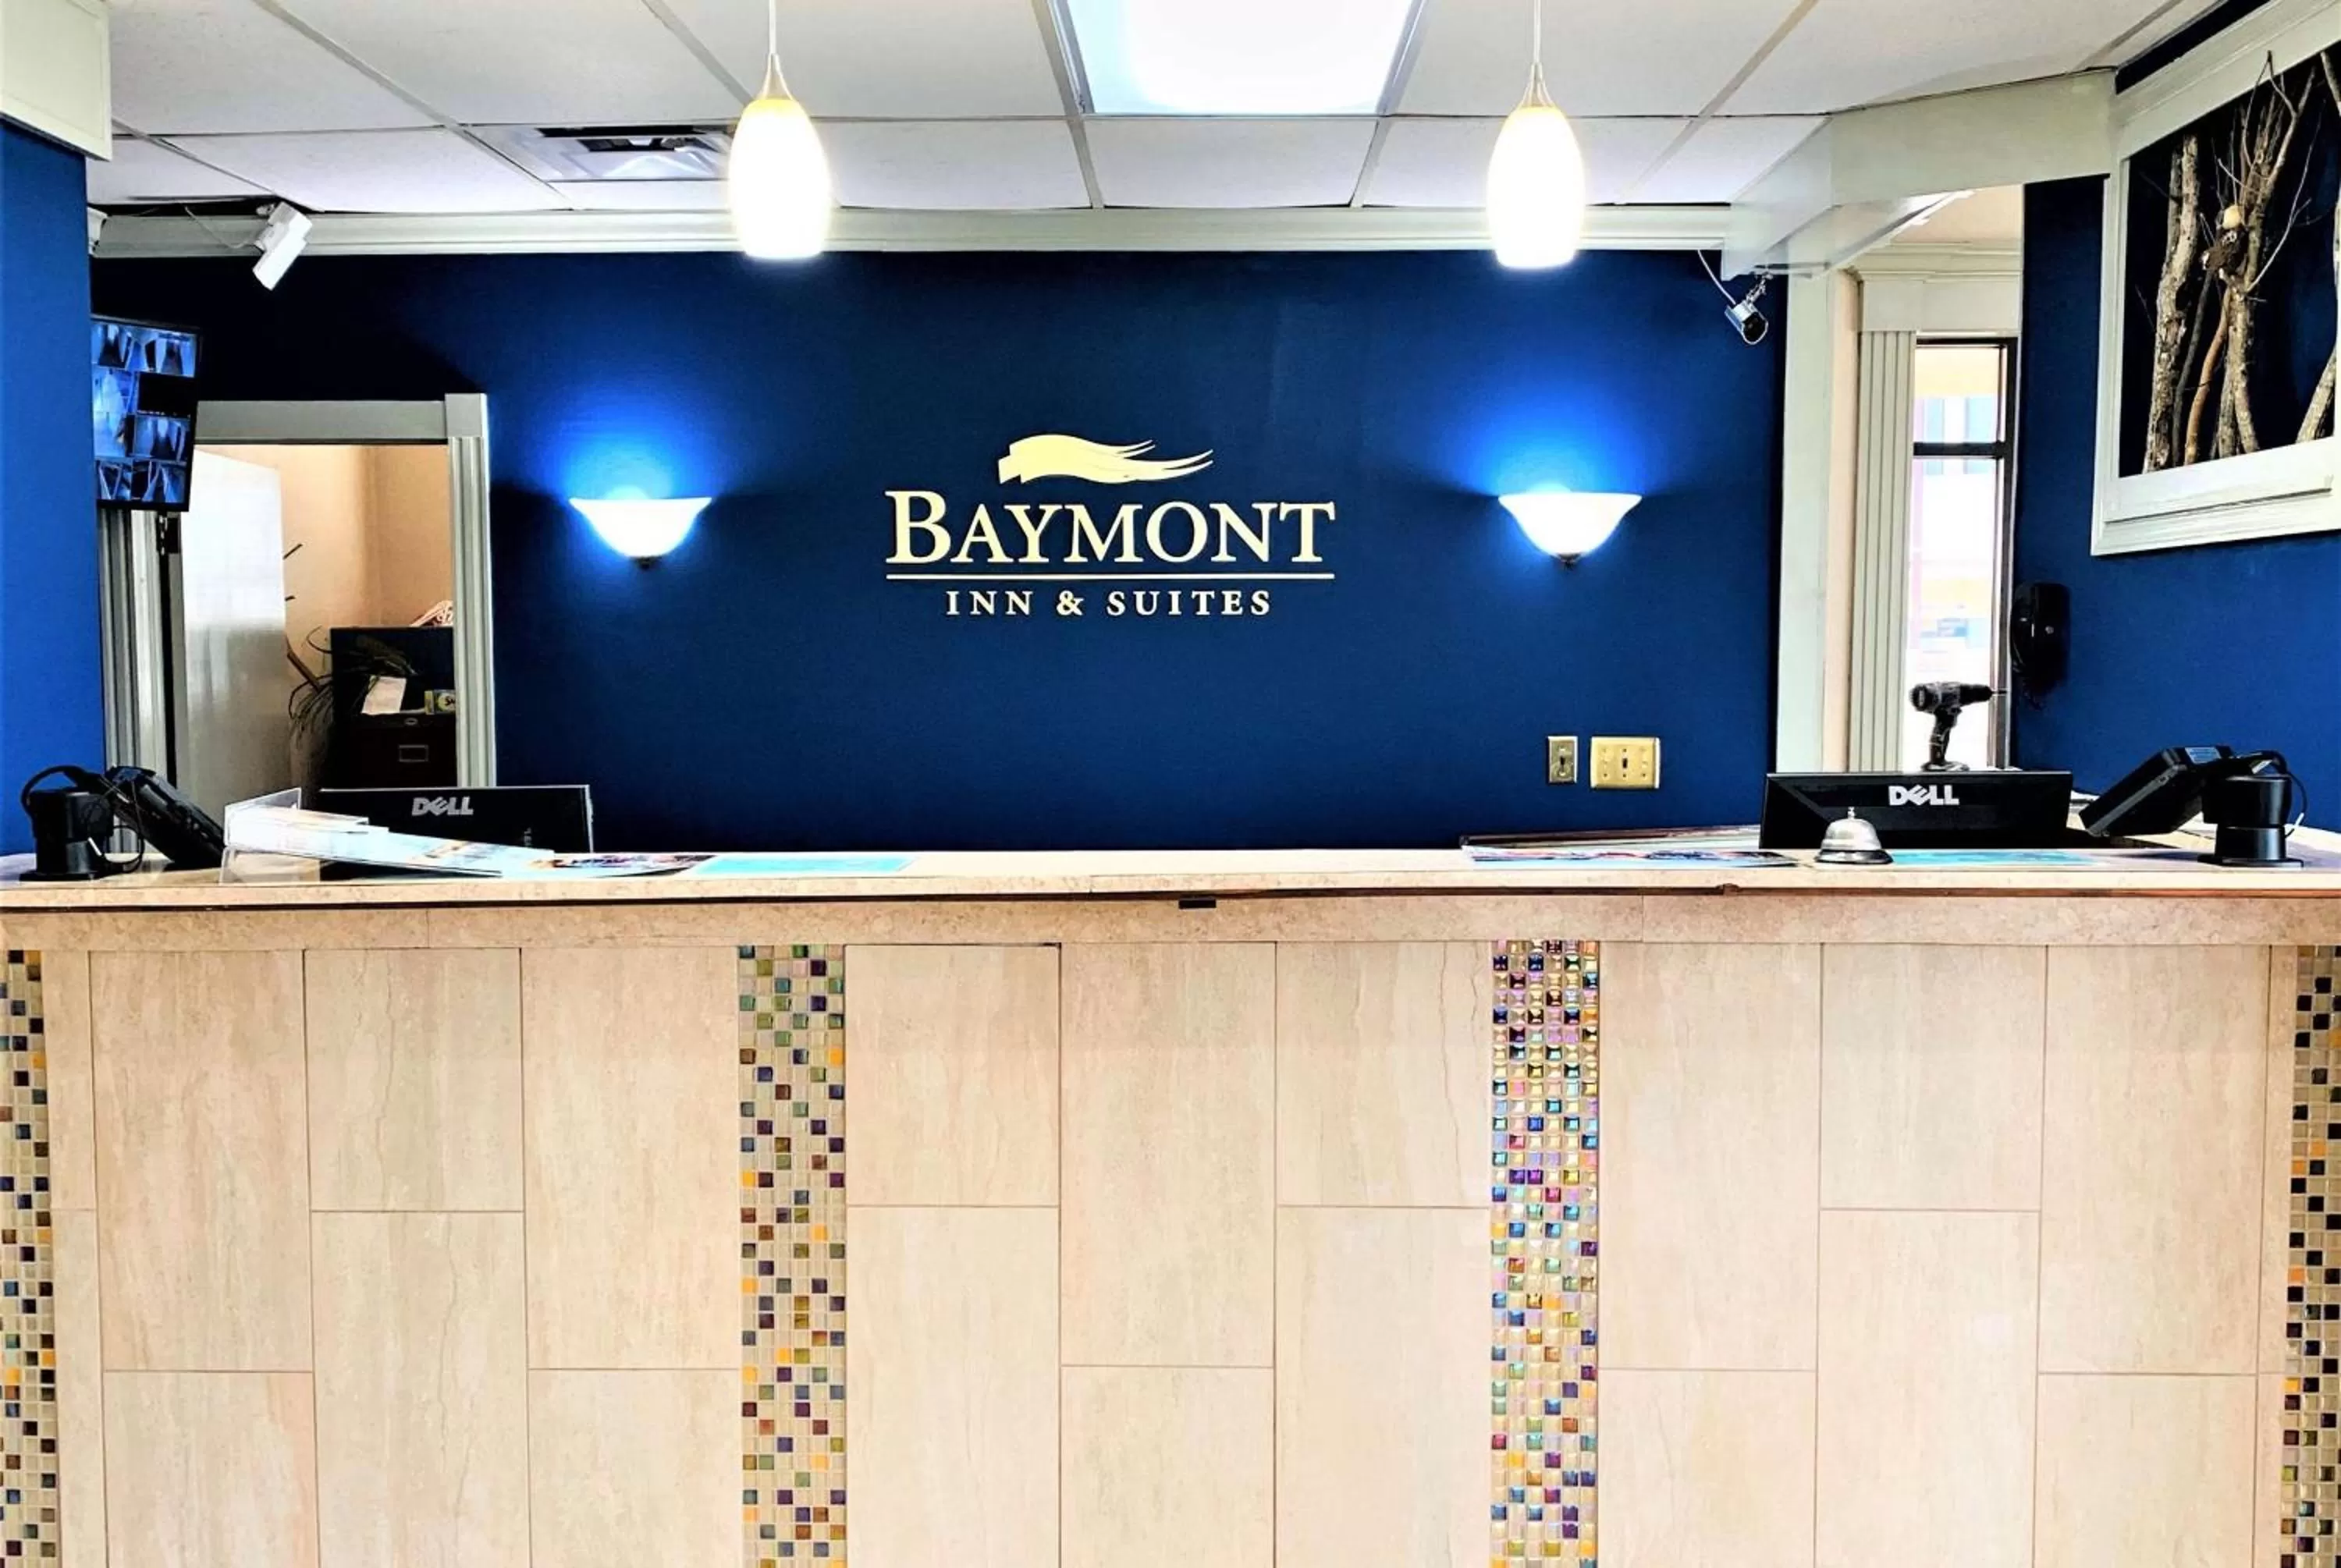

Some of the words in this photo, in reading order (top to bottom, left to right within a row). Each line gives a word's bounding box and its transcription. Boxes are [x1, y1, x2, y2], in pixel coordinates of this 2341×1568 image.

[884, 490, 1336, 563] BAYMONT
[946, 590, 1034, 616] INN
[1056, 590, 1084, 616] &
[1107, 590, 1270, 616] SUITES
[411, 796, 474, 816] DELL
[1888, 784, 1959, 806] DELL
